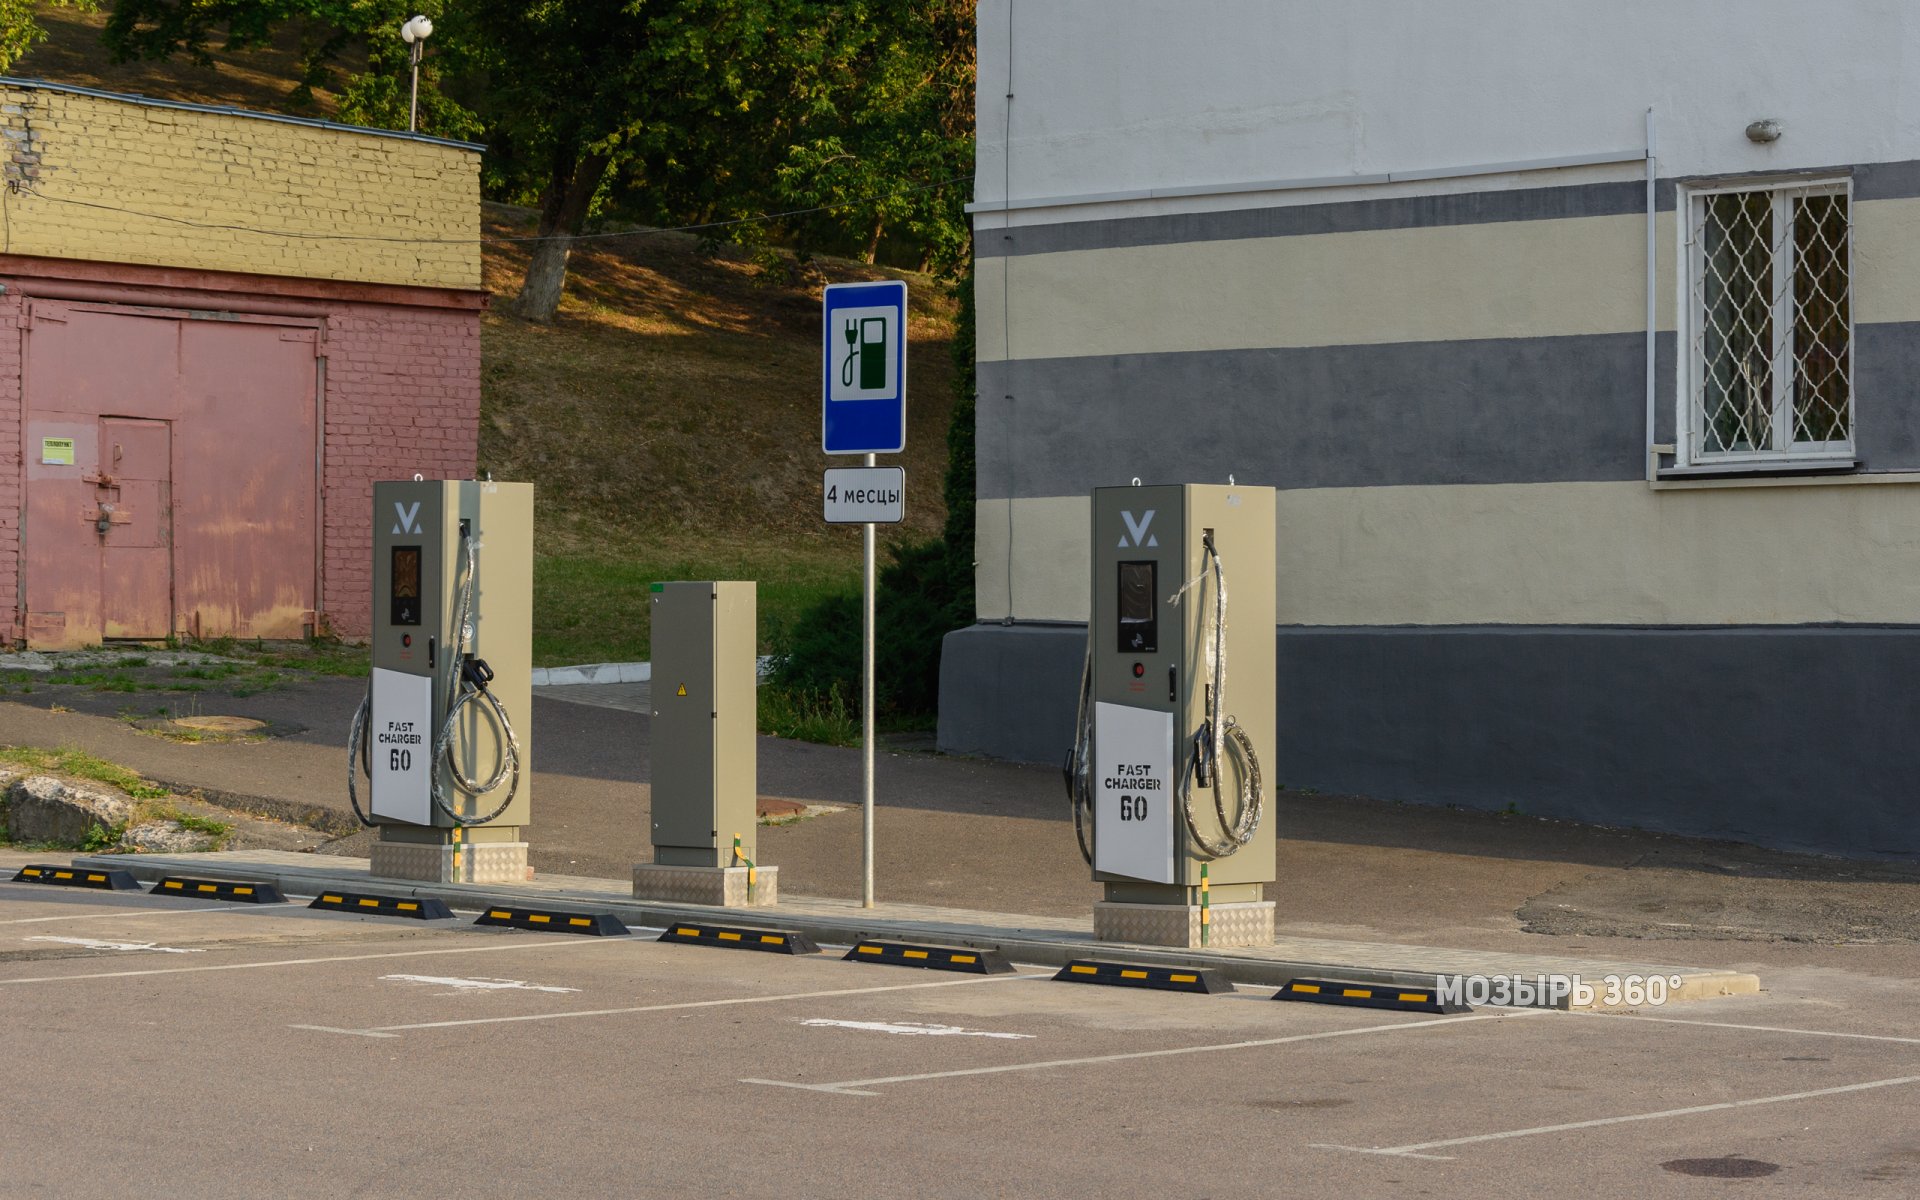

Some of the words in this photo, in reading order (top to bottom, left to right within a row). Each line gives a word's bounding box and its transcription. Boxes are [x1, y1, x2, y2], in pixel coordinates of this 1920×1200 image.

[827, 485, 837, 503] 4
[844, 489, 900, 506] месцы
[388, 721, 414, 732] FAST
[378, 733, 422, 745] CHARGER
[390, 748, 411, 771] 60
[1117, 764, 1151, 776] FAST
[1104, 777, 1161, 791] CHARGER
[1120, 795, 1148, 822] 60
